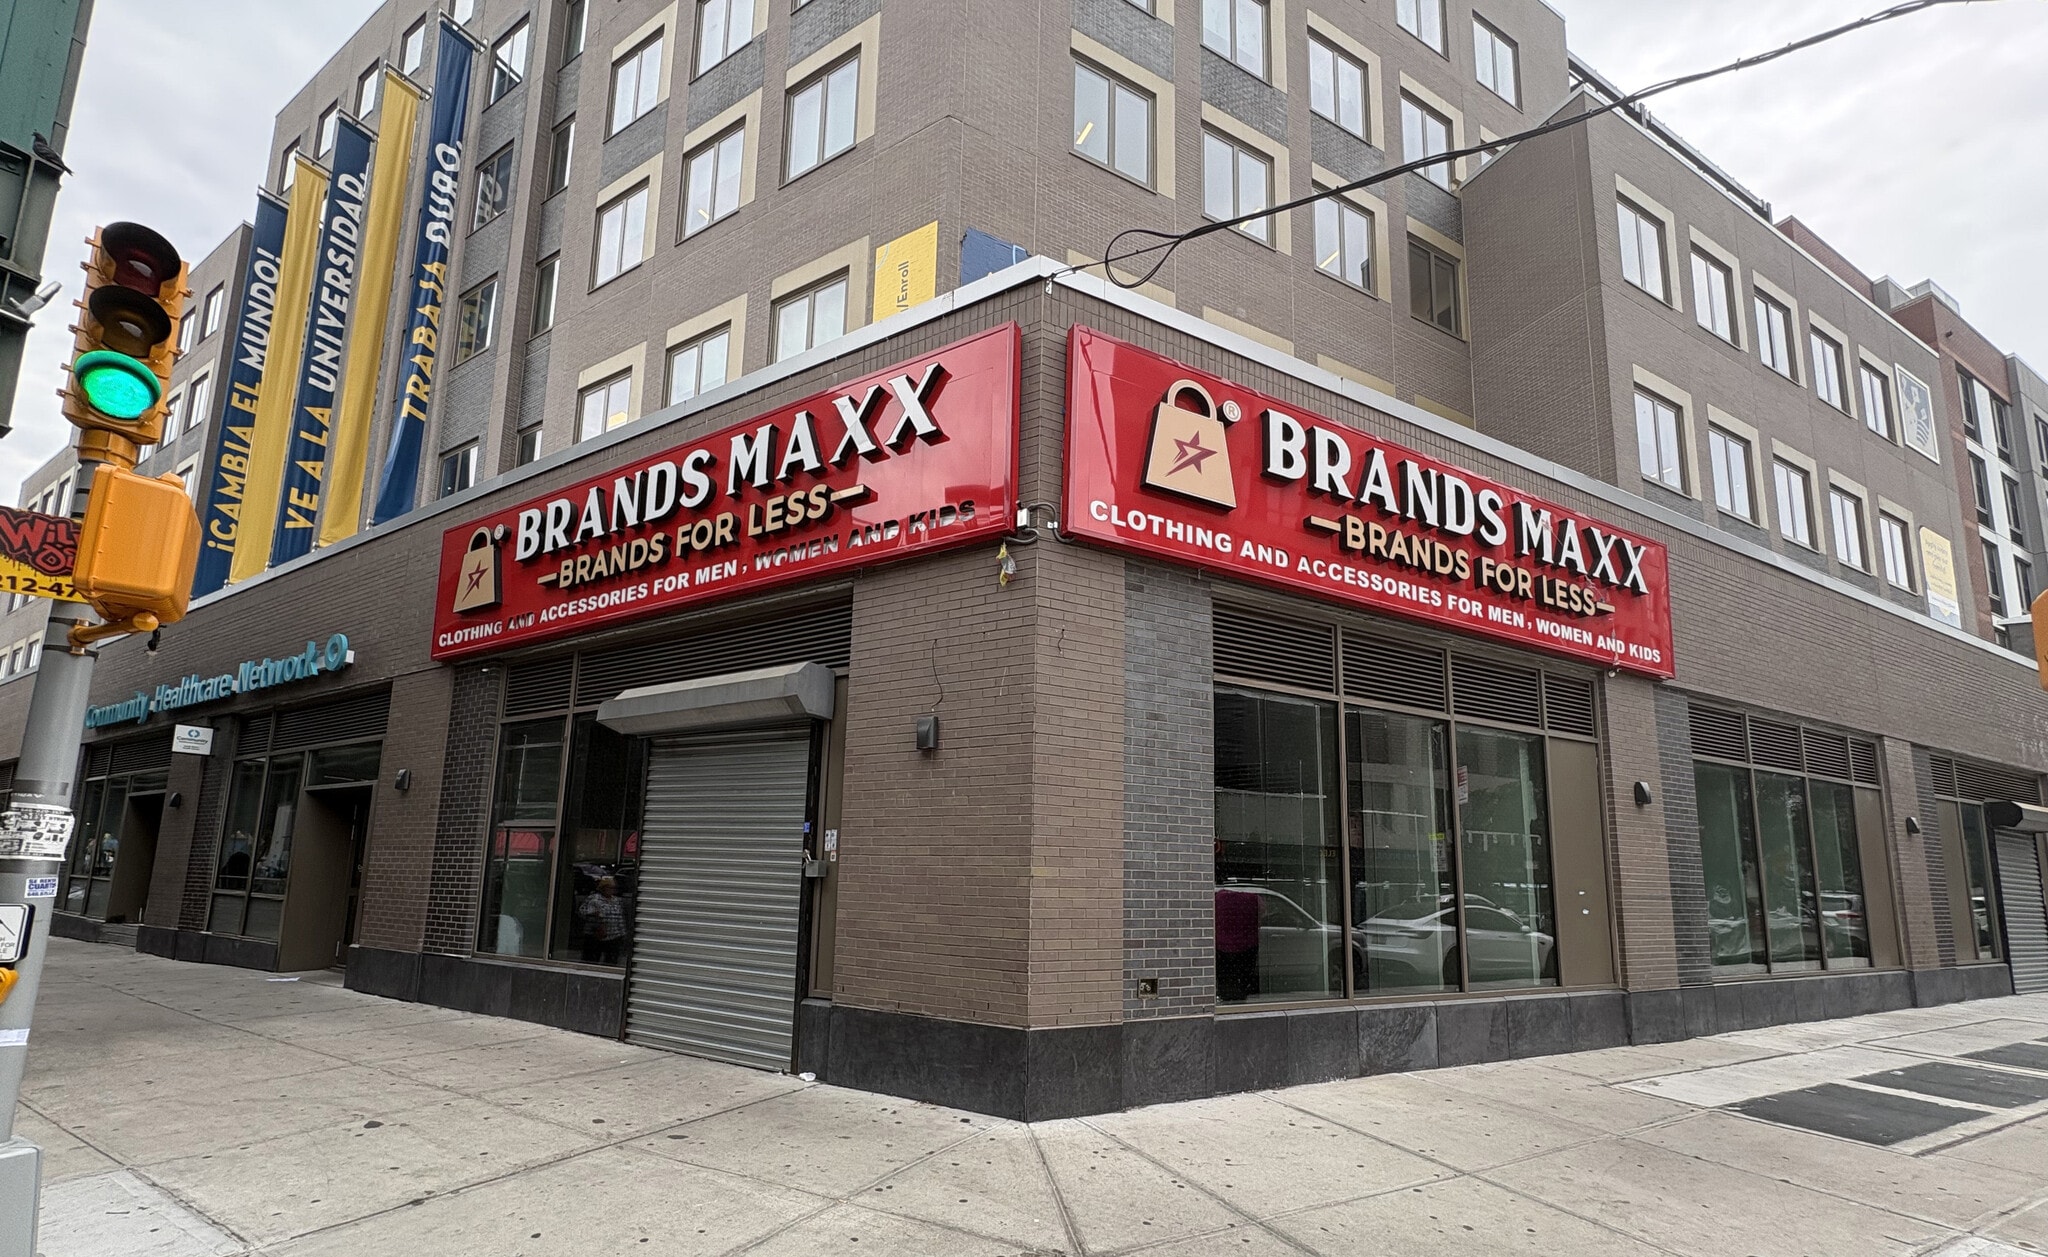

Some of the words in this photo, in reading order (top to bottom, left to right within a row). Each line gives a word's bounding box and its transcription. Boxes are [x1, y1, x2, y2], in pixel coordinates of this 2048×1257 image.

[238, 247, 282, 377] MUNDO!
[896, 260, 910, 312] /Enroll
[401, 261, 446, 421] TRABAJA
[231, 381, 260, 415] EL
[300, 406, 333, 447] LA
[295, 460, 323, 482] A
[515, 449, 711, 562] BRANDS
[725, 362, 940, 496] MAXX
[285, 487, 319, 529] VE
[675, 512, 734, 557] FOR
[1266, 408, 1508, 546] BRANDS
[1518, 501, 1649, 595] MAXX
[438, 621, 503, 648] CLOTHING
[507, 612, 535, 631] AND
[539, 583, 648, 624] ACCESSORIES
[653, 572, 690, 595] FOR
[754, 534, 839, 571] WOMEN
[846, 519, 900, 549] AND
[909, 499, 976, 535] KIDS
[1089, 500, 1233, 553] CLOTHING
[1239, 540, 1290, 568] AND
[1297, 556, 1442, 607] ACCESSORIES
[1447, 595, 1484, 618] FOR
[1536, 618, 1593, 646] WOMEN
[1596, 635, 1626, 654] AND
[1629, 643, 1662, 663] KIDS
[1482, 556, 1533, 599] FOR
[84, 690, 151, 729] Community
[154, 673, 233, 712] Healthcare
[236, 640, 319, 694] Network
